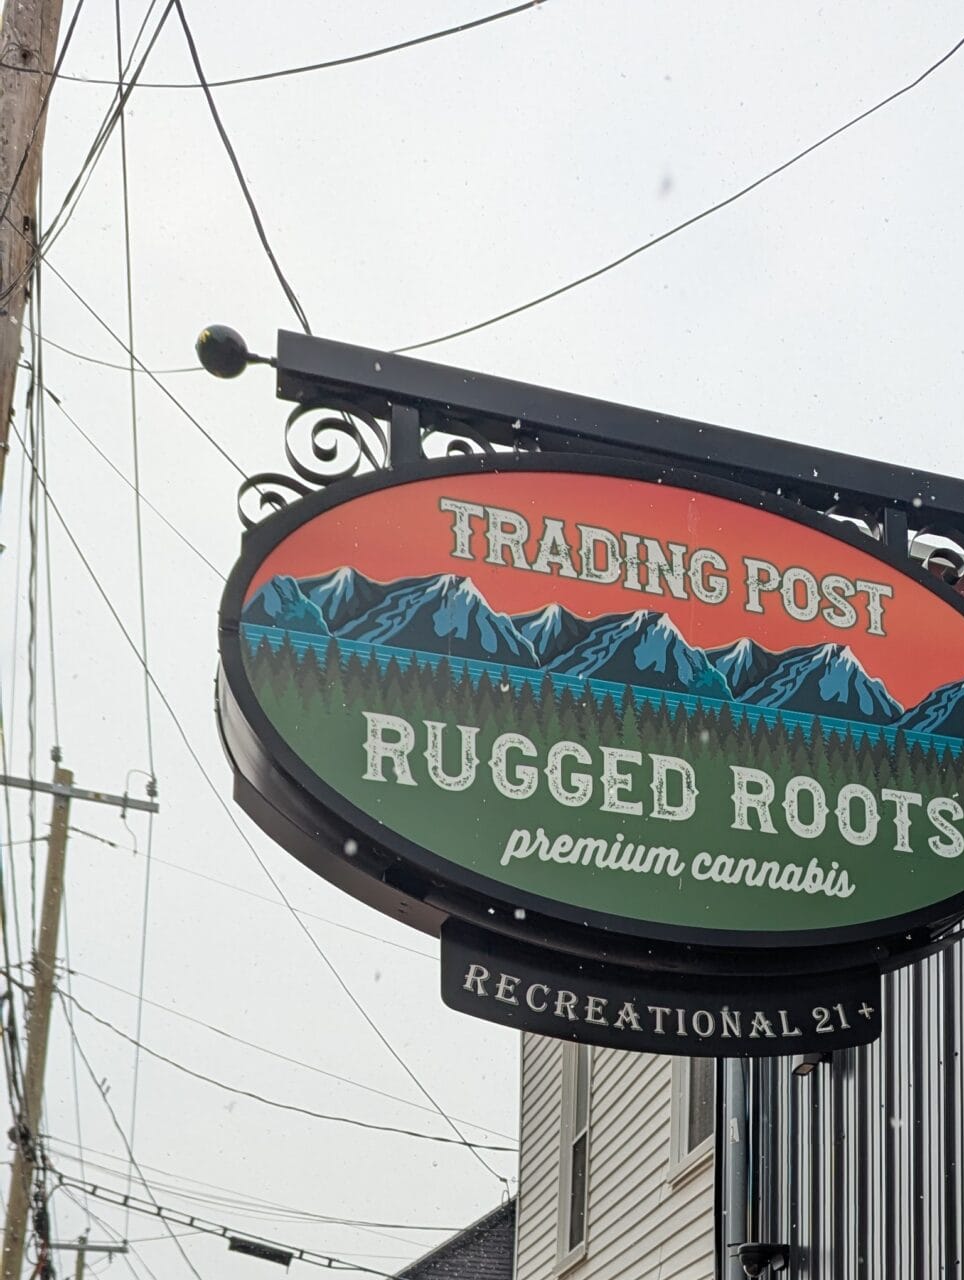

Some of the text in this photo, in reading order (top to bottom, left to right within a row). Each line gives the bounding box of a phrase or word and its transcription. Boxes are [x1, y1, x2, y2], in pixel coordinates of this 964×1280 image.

[439, 497, 895, 639] TRADING POST
[361, 711, 698, 822] RUGGED
[500, 827, 856, 899] premium cannabis
[463, 964, 876, 1039] RECREATIONAL 21+
